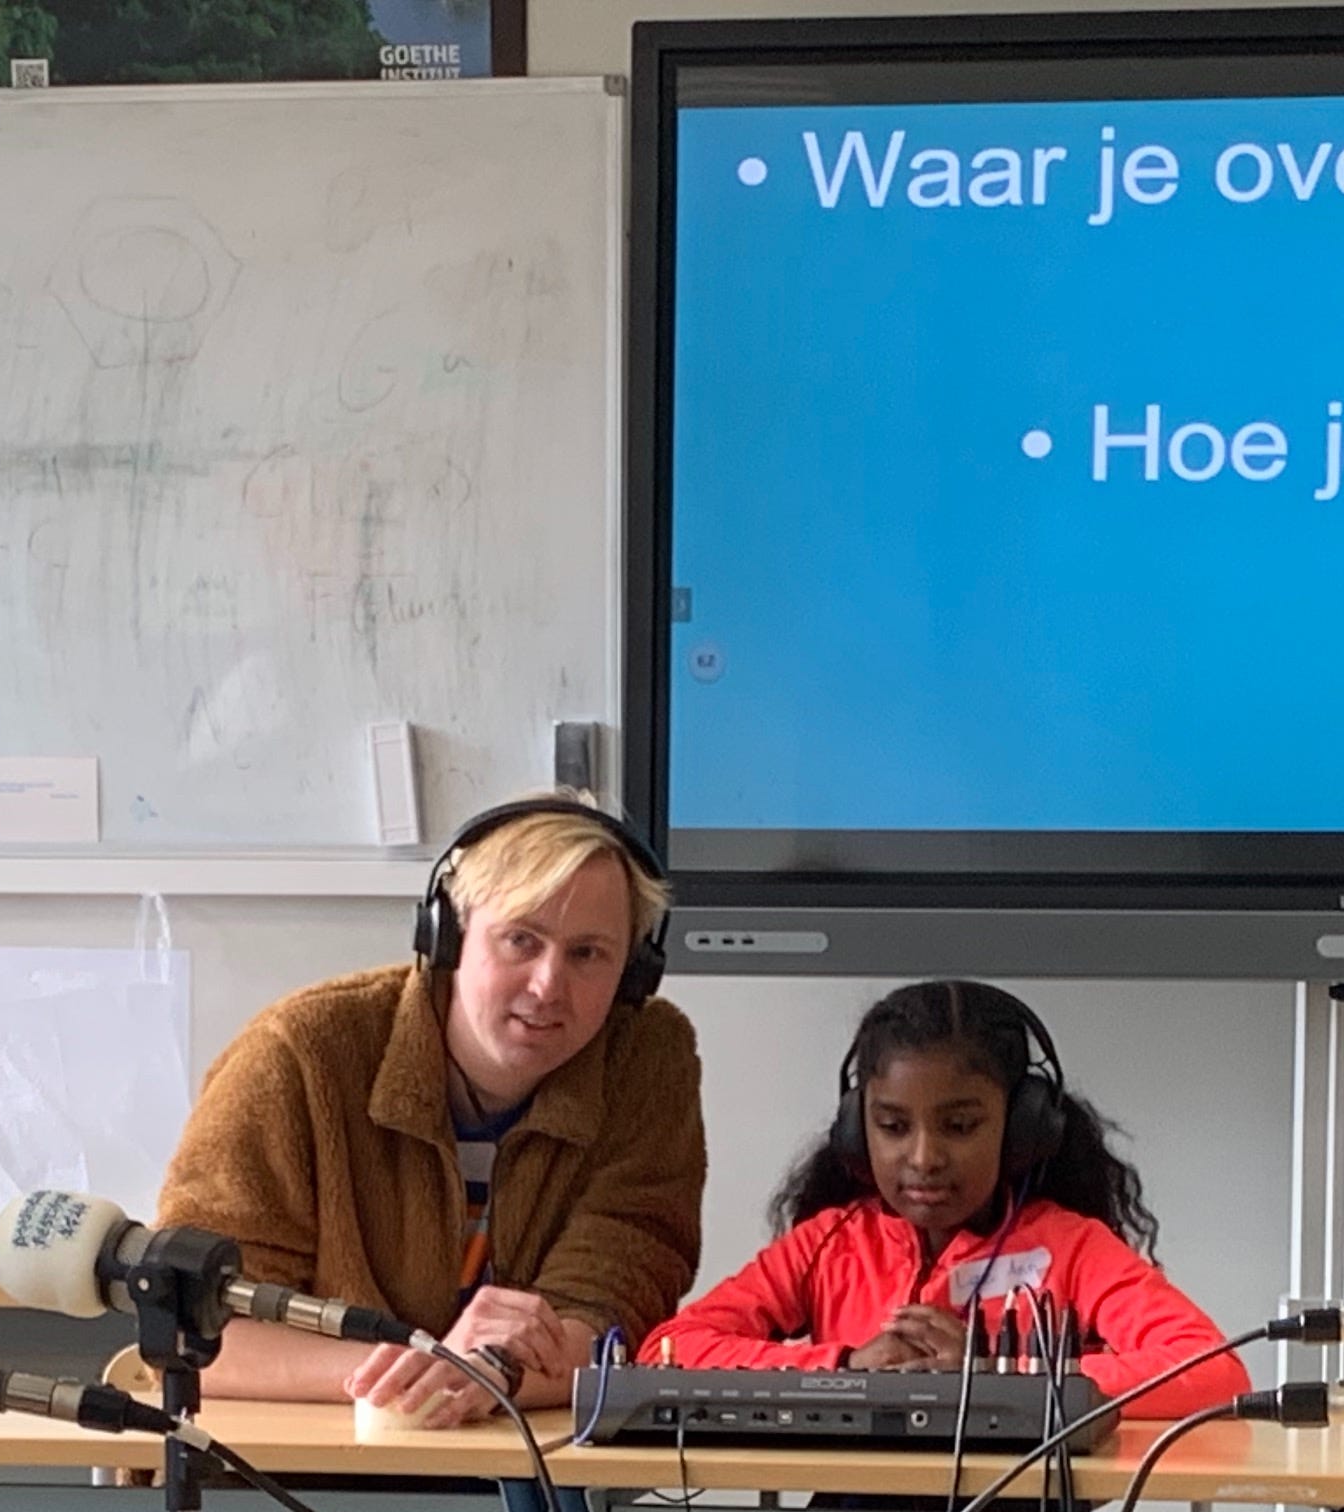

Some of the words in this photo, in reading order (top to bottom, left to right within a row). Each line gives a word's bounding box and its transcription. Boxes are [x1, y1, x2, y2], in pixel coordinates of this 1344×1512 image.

[379, 44, 460, 65] GOETHE
[803, 130, 1067, 208] Waar
[1088, 126, 1179, 225] je
[1093, 404, 1288, 481] Hoe
